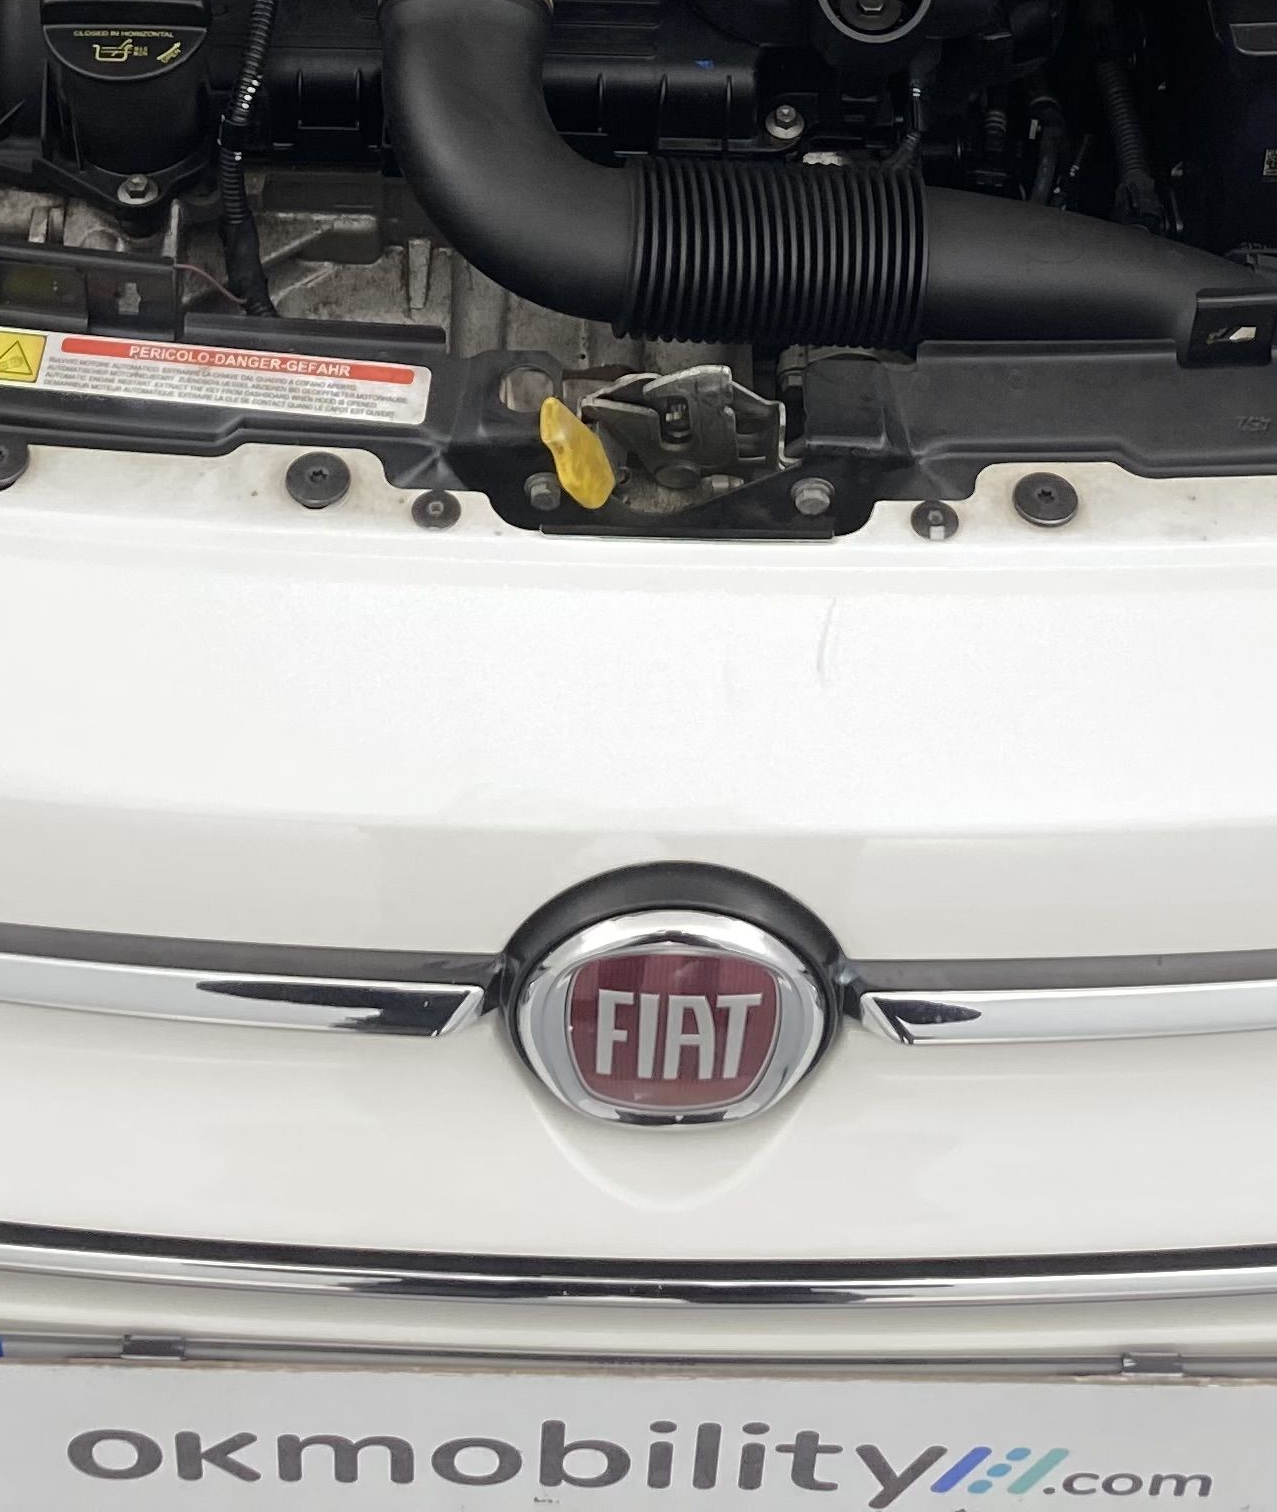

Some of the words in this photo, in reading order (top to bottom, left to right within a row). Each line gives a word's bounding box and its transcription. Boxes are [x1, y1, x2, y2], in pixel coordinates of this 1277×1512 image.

[129, 345, 351, 377] PERICOLO-DANGER-GEFAHR
[596, 989, 763, 1081] FIAT
[67, 1420, 948, 1509] okmobility
[1043, 1472, 1213, 1497] .com
